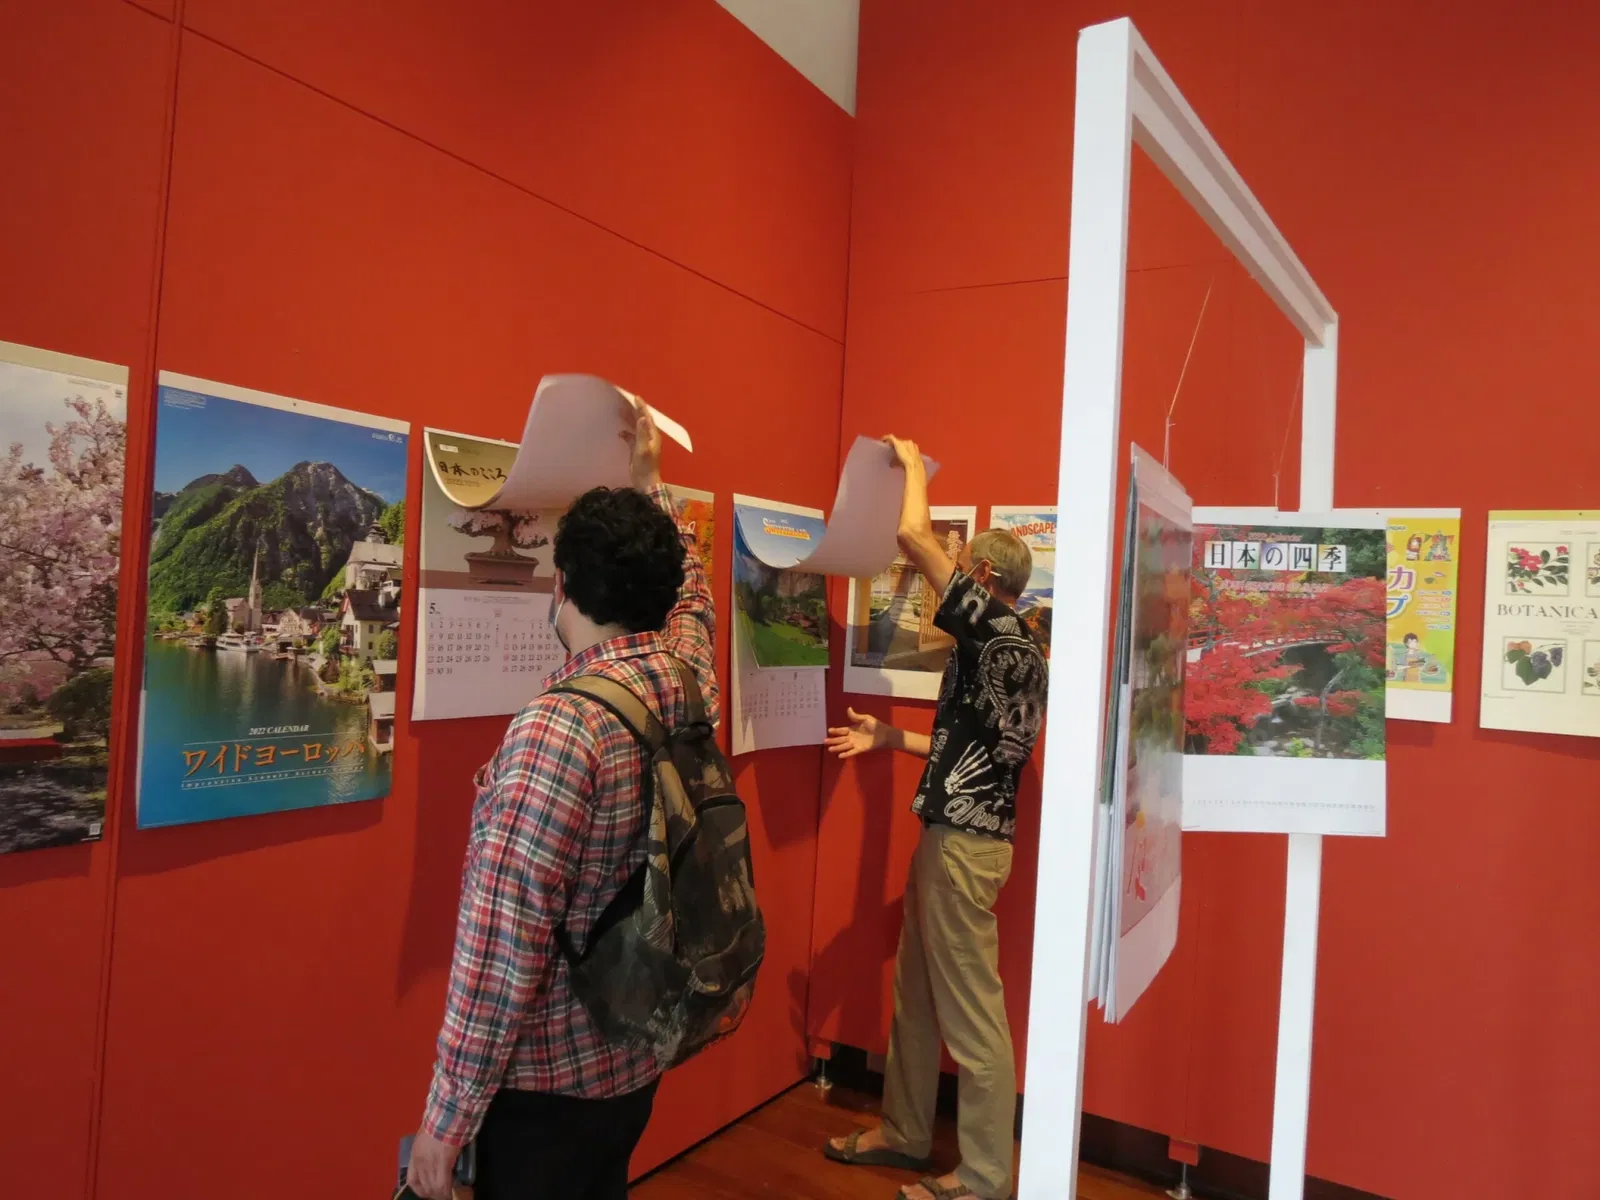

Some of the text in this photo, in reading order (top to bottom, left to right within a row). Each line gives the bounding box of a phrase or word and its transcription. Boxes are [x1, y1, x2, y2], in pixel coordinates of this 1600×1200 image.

[1011, 522, 1056, 537] ANDSCAPE
[1211, 543, 1342, 570] 日本の四季
[429, 602, 436, 614] 5
[248, 724, 310, 736] 2022 CALENDAR
[182, 740, 366, 777] ワイドヨーロッパ
